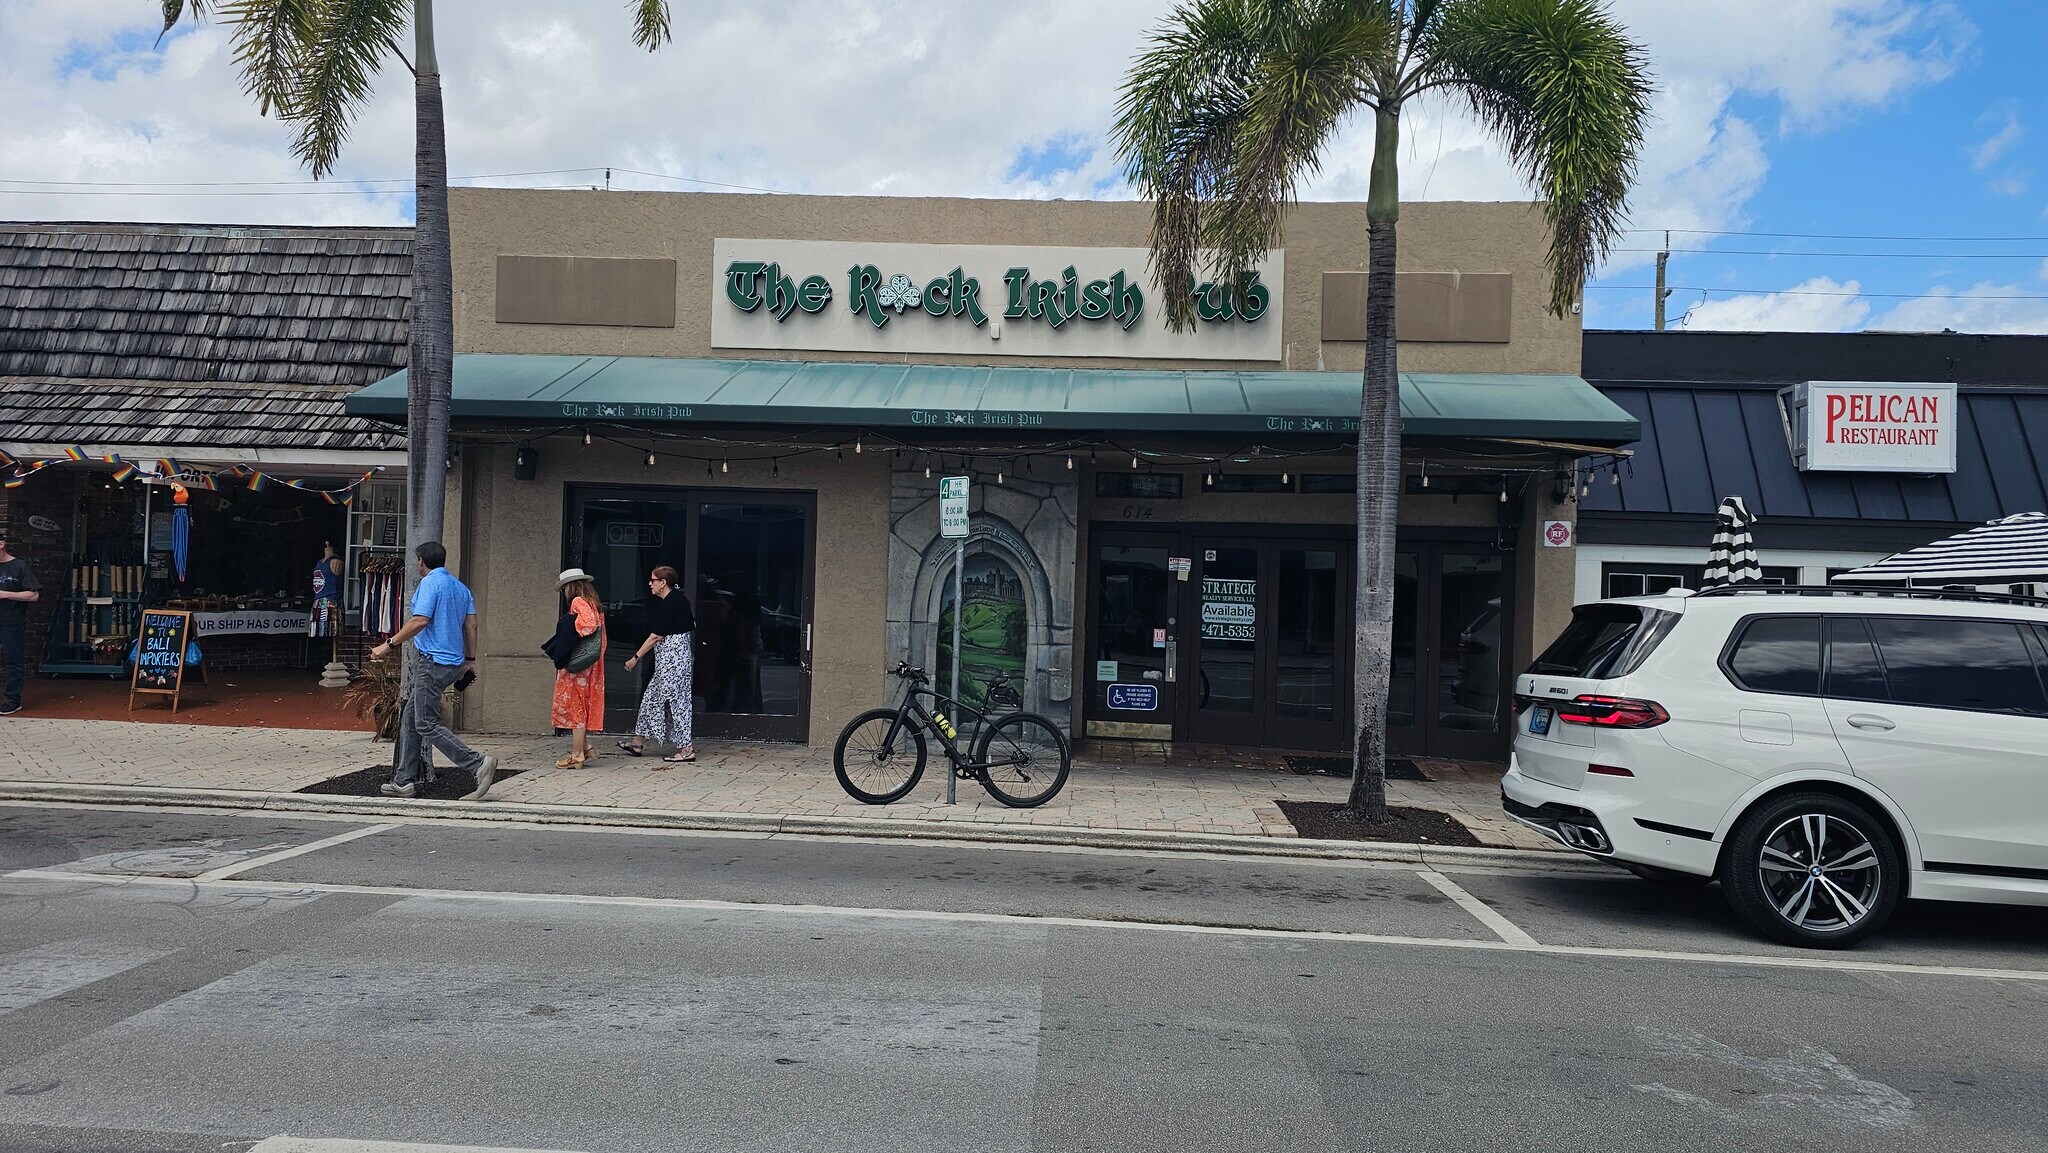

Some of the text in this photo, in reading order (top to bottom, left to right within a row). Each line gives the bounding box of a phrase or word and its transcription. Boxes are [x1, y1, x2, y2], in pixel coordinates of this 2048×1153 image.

[725, 261, 832, 323] The
[1002, 264, 1145, 330] Irish
[562, 403, 588, 417] The
[632, 404, 663, 418] Irish
[667, 406, 692, 419] Pub
[911, 411, 938, 425] The
[982, 412, 1013, 427] Irish
[1017, 413, 1043, 427] Pub
[1266, 416, 1294, 430] The
[1826, 395, 1938, 443] PELICAN
[1841, 428, 1938, 445] RESTAURANT
[942, 483, 949, 498] 4
[1123, 505, 1153, 519] 614
[609, 526, 661, 544] OPEN
[1203, 605, 1254, 617] Available
[145, 615, 182, 628] WELCOME
[218, 619, 244, 630] SHIP
[247, 619, 270, 629] HAS
[273, 618, 306, 629] COME
[1206, 624, 1256, 638] 471-5353
[147, 637, 170, 650] BALI
[139, 651, 180, 667] IMPORTERS
